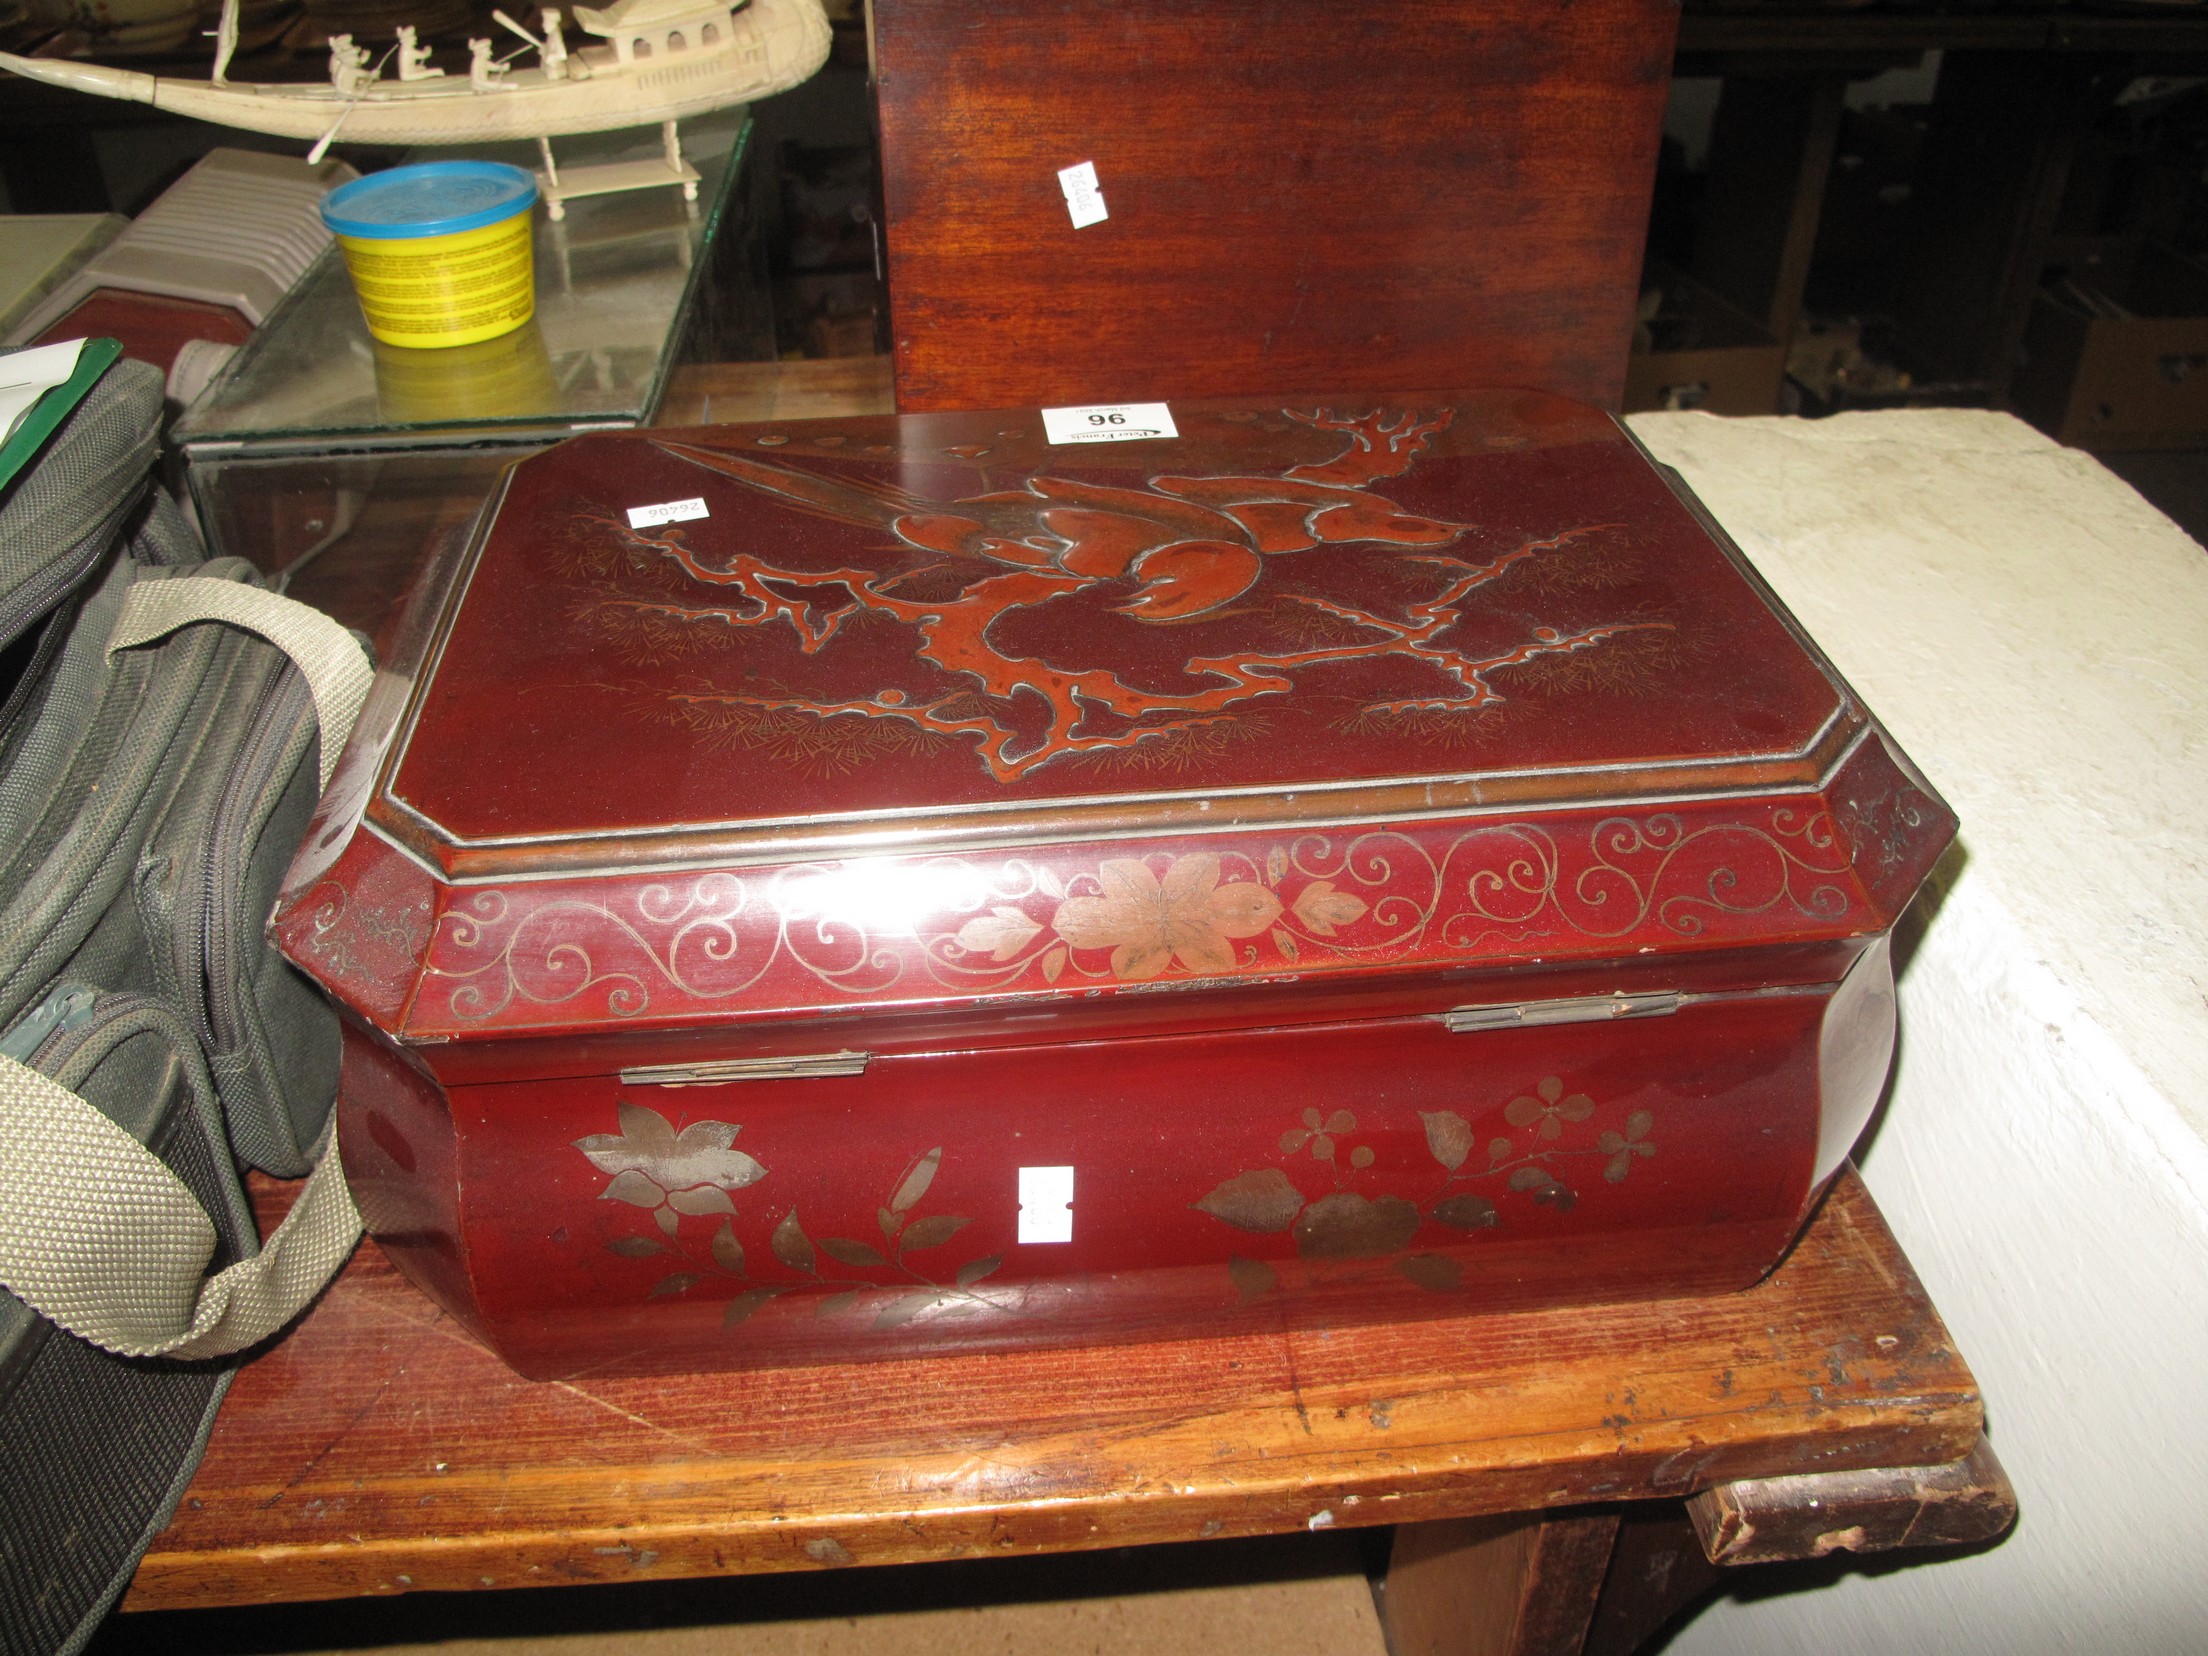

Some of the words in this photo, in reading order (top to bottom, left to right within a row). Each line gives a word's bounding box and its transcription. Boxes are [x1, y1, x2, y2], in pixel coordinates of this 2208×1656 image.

[1069, 170, 1093, 211] 26406
[1088, 413, 1126, 426] 96
[1070, 432, 1115, 440] Francis
[1118, 431, 1148, 439] Peter
[648, 502, 700, 519] 26406
